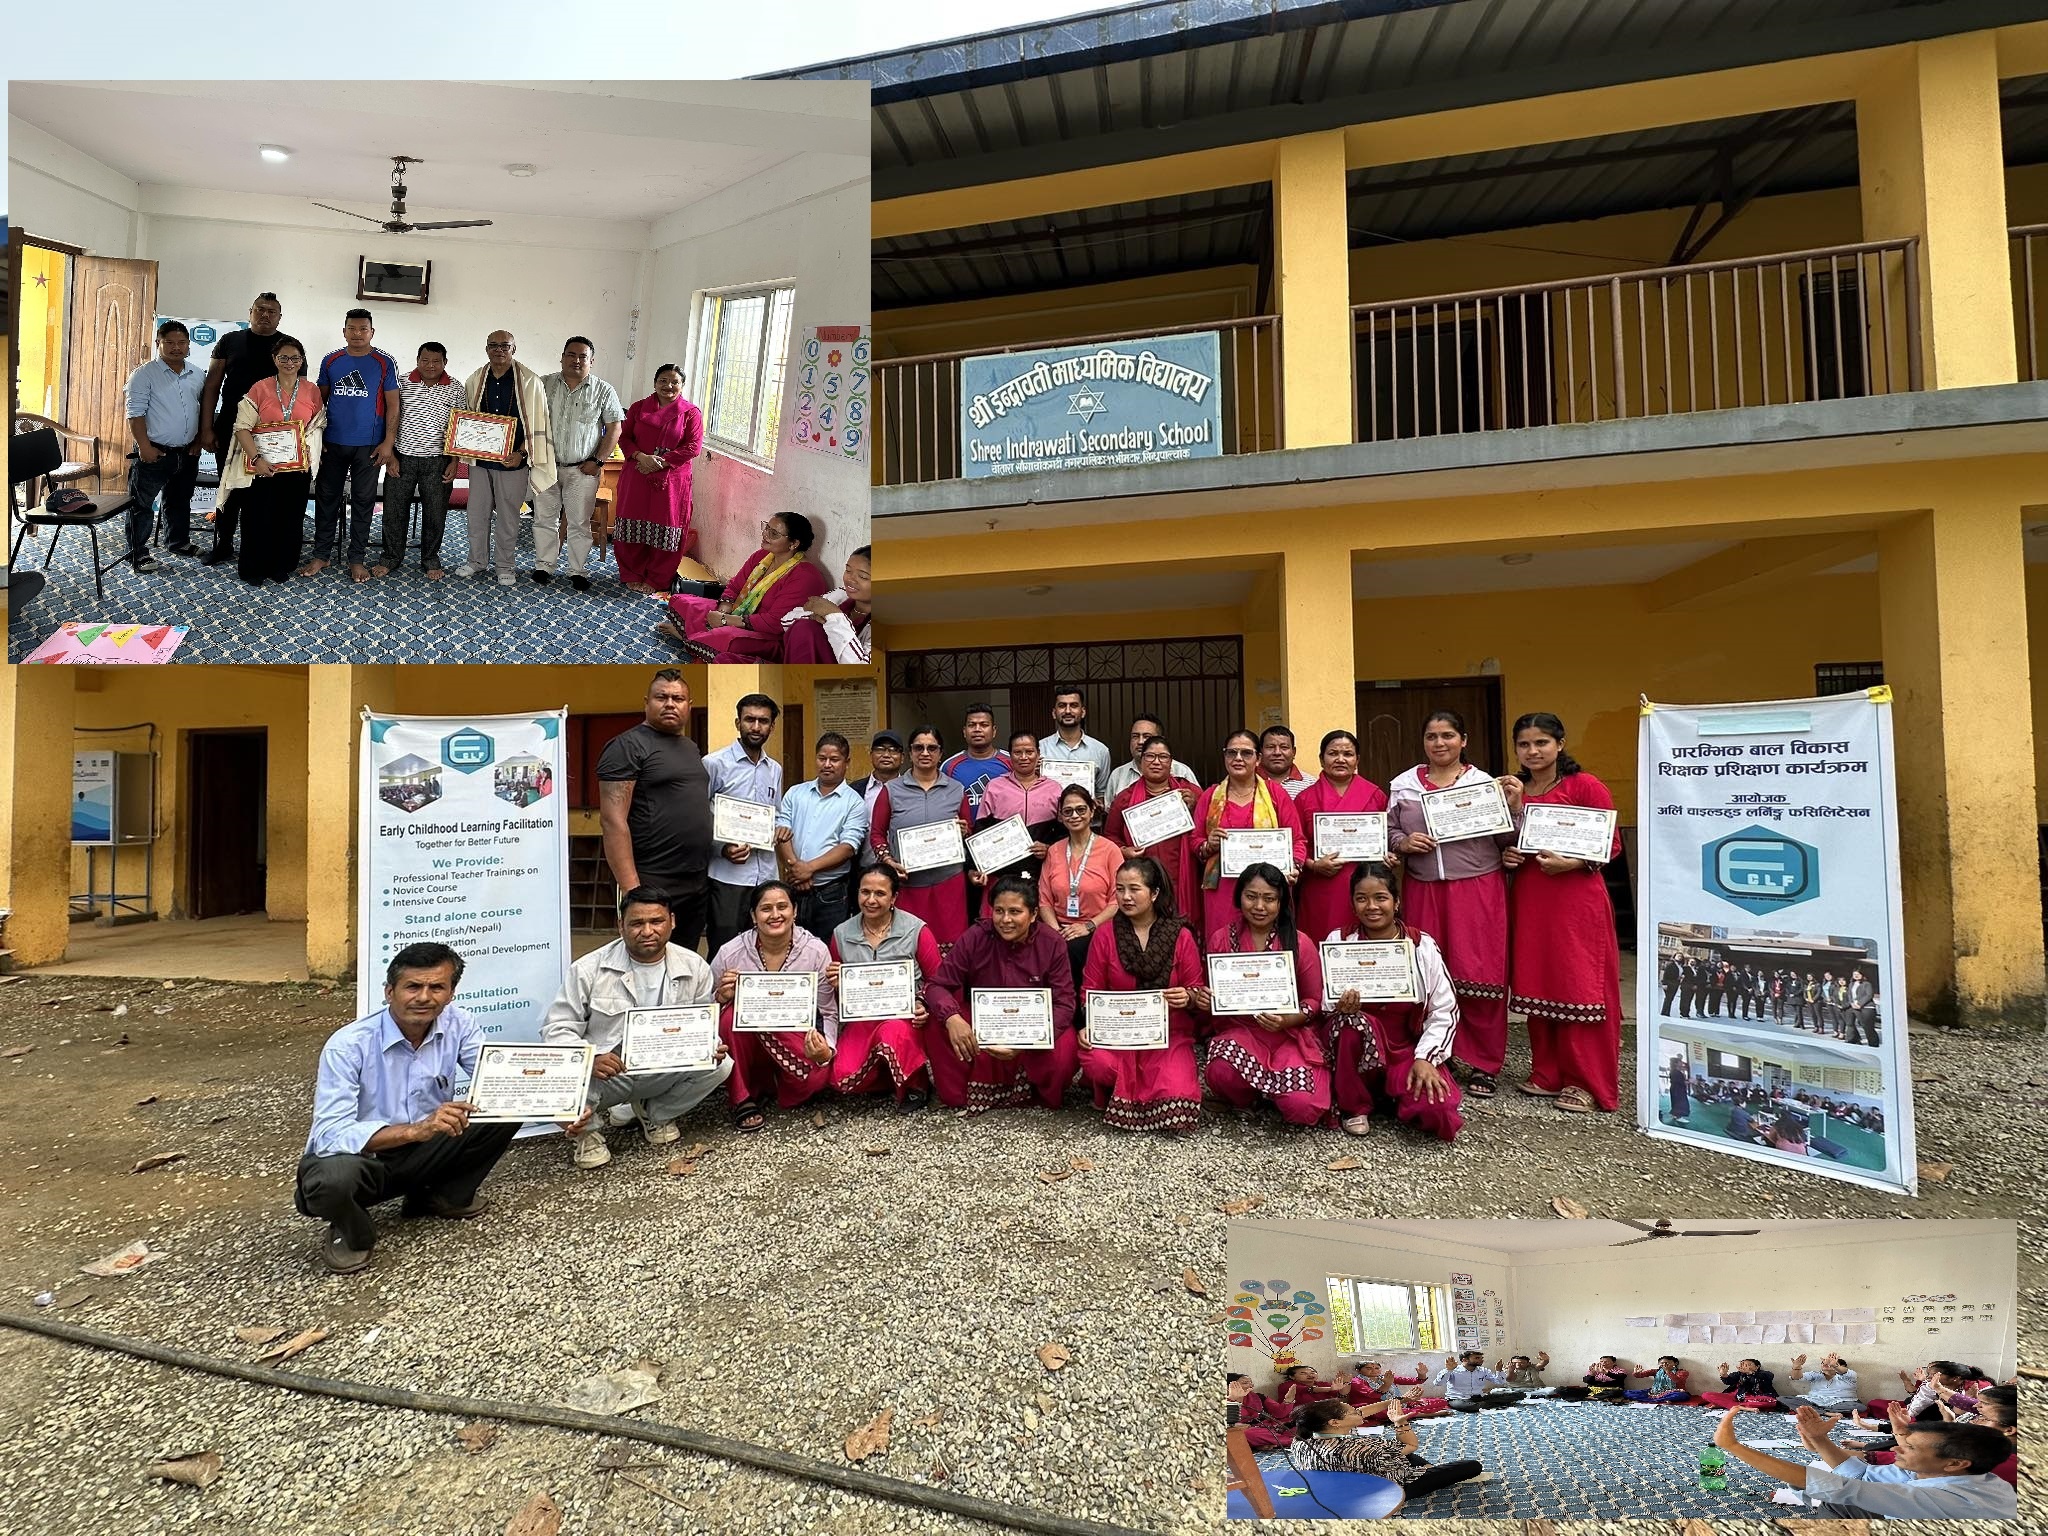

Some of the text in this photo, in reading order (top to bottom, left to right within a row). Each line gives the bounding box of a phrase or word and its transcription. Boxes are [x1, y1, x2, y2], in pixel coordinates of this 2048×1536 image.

[808, 341, 818, 357] 0
[854, 342, 869, 359] 6
[806, 368, 814, 384] 1
[853, 372, 866, 390] 7
[334, 385, 369, 397] adidas
[827, 377, 838, 394] 5
[968, 394, 995, 429] श्री
[1052, 348, 1136, 387] माध्यमिक
[1135, 350, 1213, 403] विद्यालय
[801, 394, 812, 410] 2
[820, 407, 832, 424] 4
[850, 402, 862, 420] 8
[798, 422, 808, 438] 3
[845, 430, 860, 448] 9
[970, 418, 1210, 463] Shree Indrawati Secondary School
[1672, 739, 1850, 760] प्रारम्भिक बाल विकास
[1658, 758, 1868, 778] शिक्षक प्रशिक्षण कार्यक्रम
[1731, 792, 1787, 804] आयोजक
[1687, 806, 1742, 818] चाइल्डहुड
[1788, 805, 1870, 818] फसिलिटेसन
[380, 818, 554, 839] Early Childhood Learning Facilitation
[416, 836, 520, 850] Together for Better Future
[432, 856, 504, 868] We Provide:
[393, 866, 538, 884] Professional Teacher Trainings on
[393, 884, 458, 896] Novice Course
[393, 894, 467, 907] Intensive Course
[405, 908, 522, 924] Stand alone course
[393, 923, 502, 940] Phonics (English/Nepali)
[458, 942, 550, 958] ssional Development
[452, 987, 518, 1001] onsultation
[458, 1000, 530, 1014] onsulation
